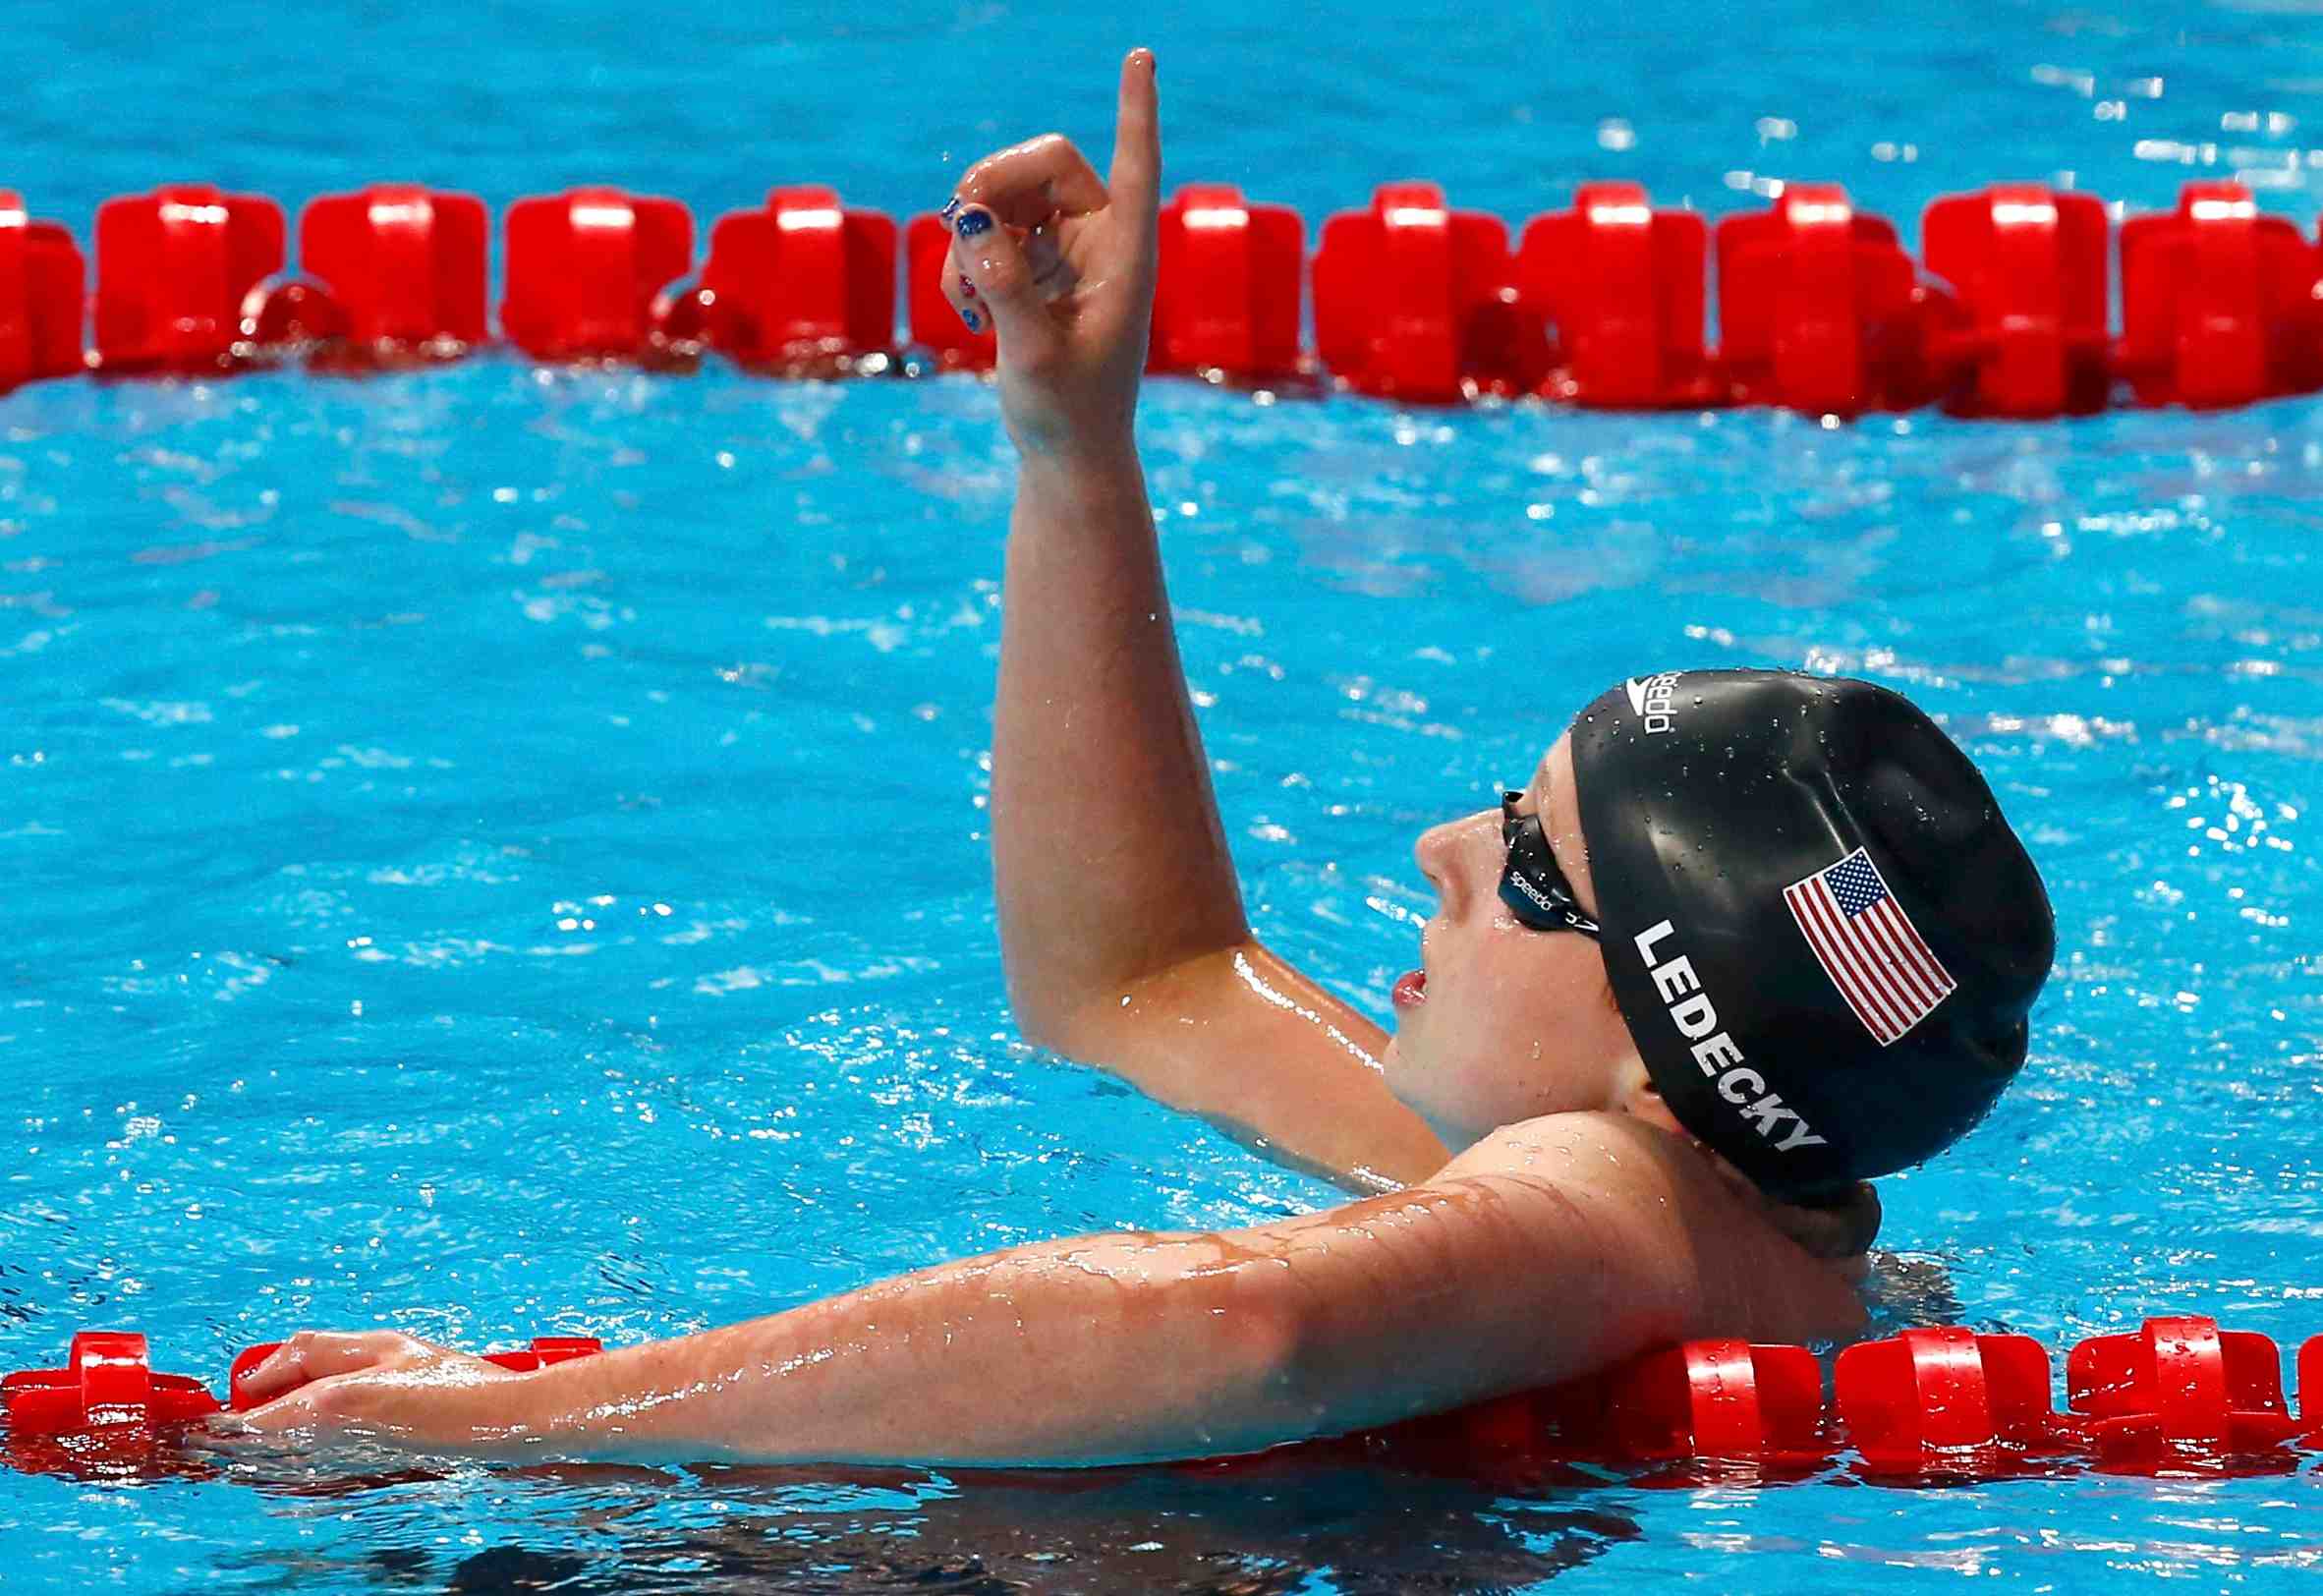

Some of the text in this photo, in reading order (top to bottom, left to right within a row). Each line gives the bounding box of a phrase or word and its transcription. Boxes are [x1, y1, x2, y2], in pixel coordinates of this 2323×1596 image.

[1644, 671, 1682, 735] eedo
[1510, 871, 1553, 911] speedo
[1634, 919, 1828, 1152] LEDECKY
